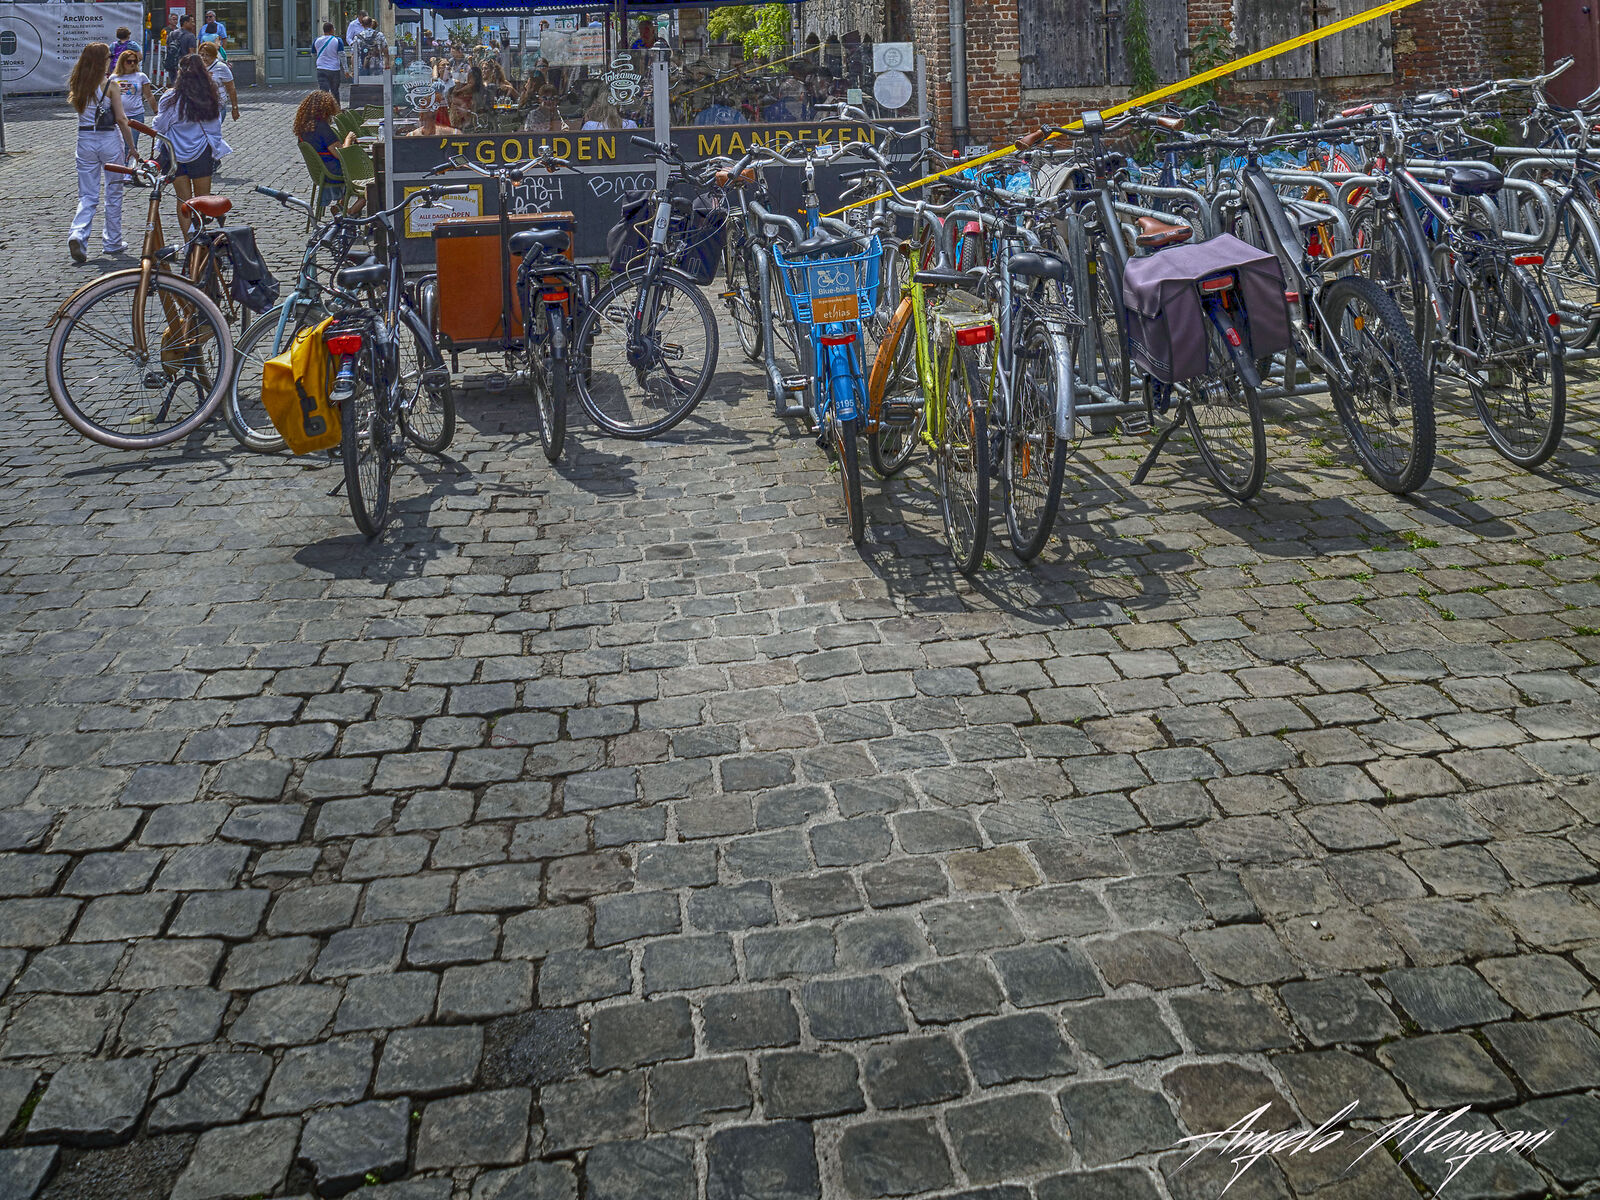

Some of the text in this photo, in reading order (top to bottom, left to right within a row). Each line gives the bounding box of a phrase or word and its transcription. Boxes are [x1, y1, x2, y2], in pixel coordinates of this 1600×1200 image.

[600, 70, 642, 85] Takeaway
[818, 286, 851, 295] Blue-bike
[823, 303, 851, 320] ethias
